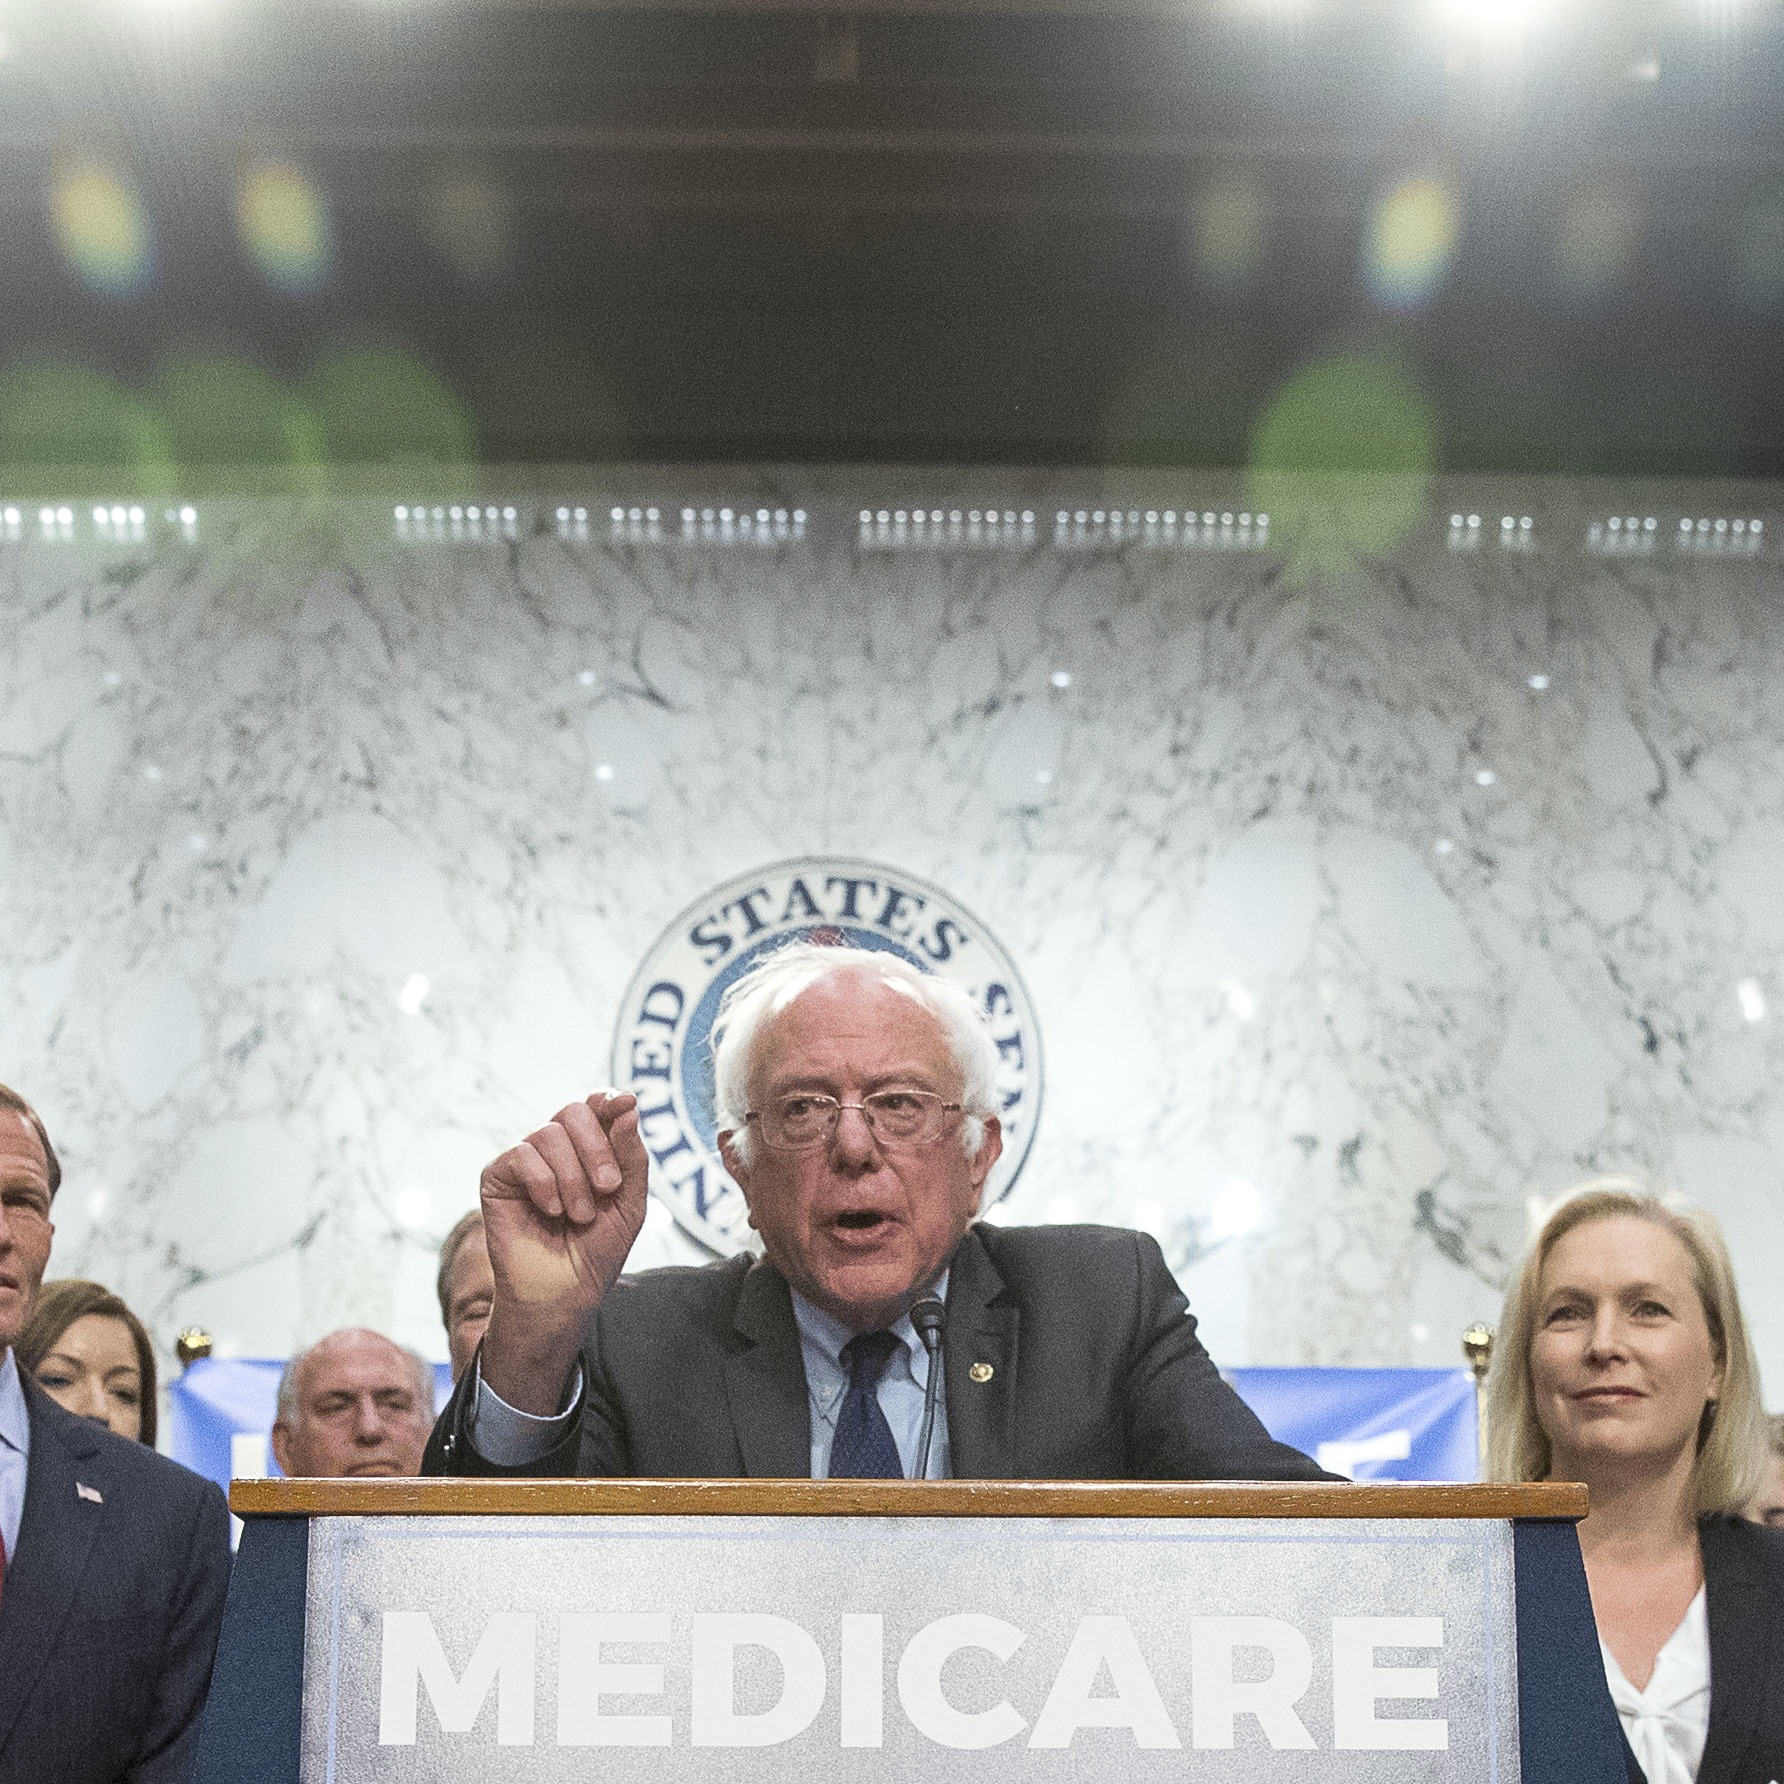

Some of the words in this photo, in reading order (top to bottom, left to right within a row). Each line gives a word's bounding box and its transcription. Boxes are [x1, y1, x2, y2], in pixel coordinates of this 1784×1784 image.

[628, 982, 729, 1235] NITED
[689, 877, 968, 965] STATES
[379, 1612, 1449, 1751] MEDICARE
